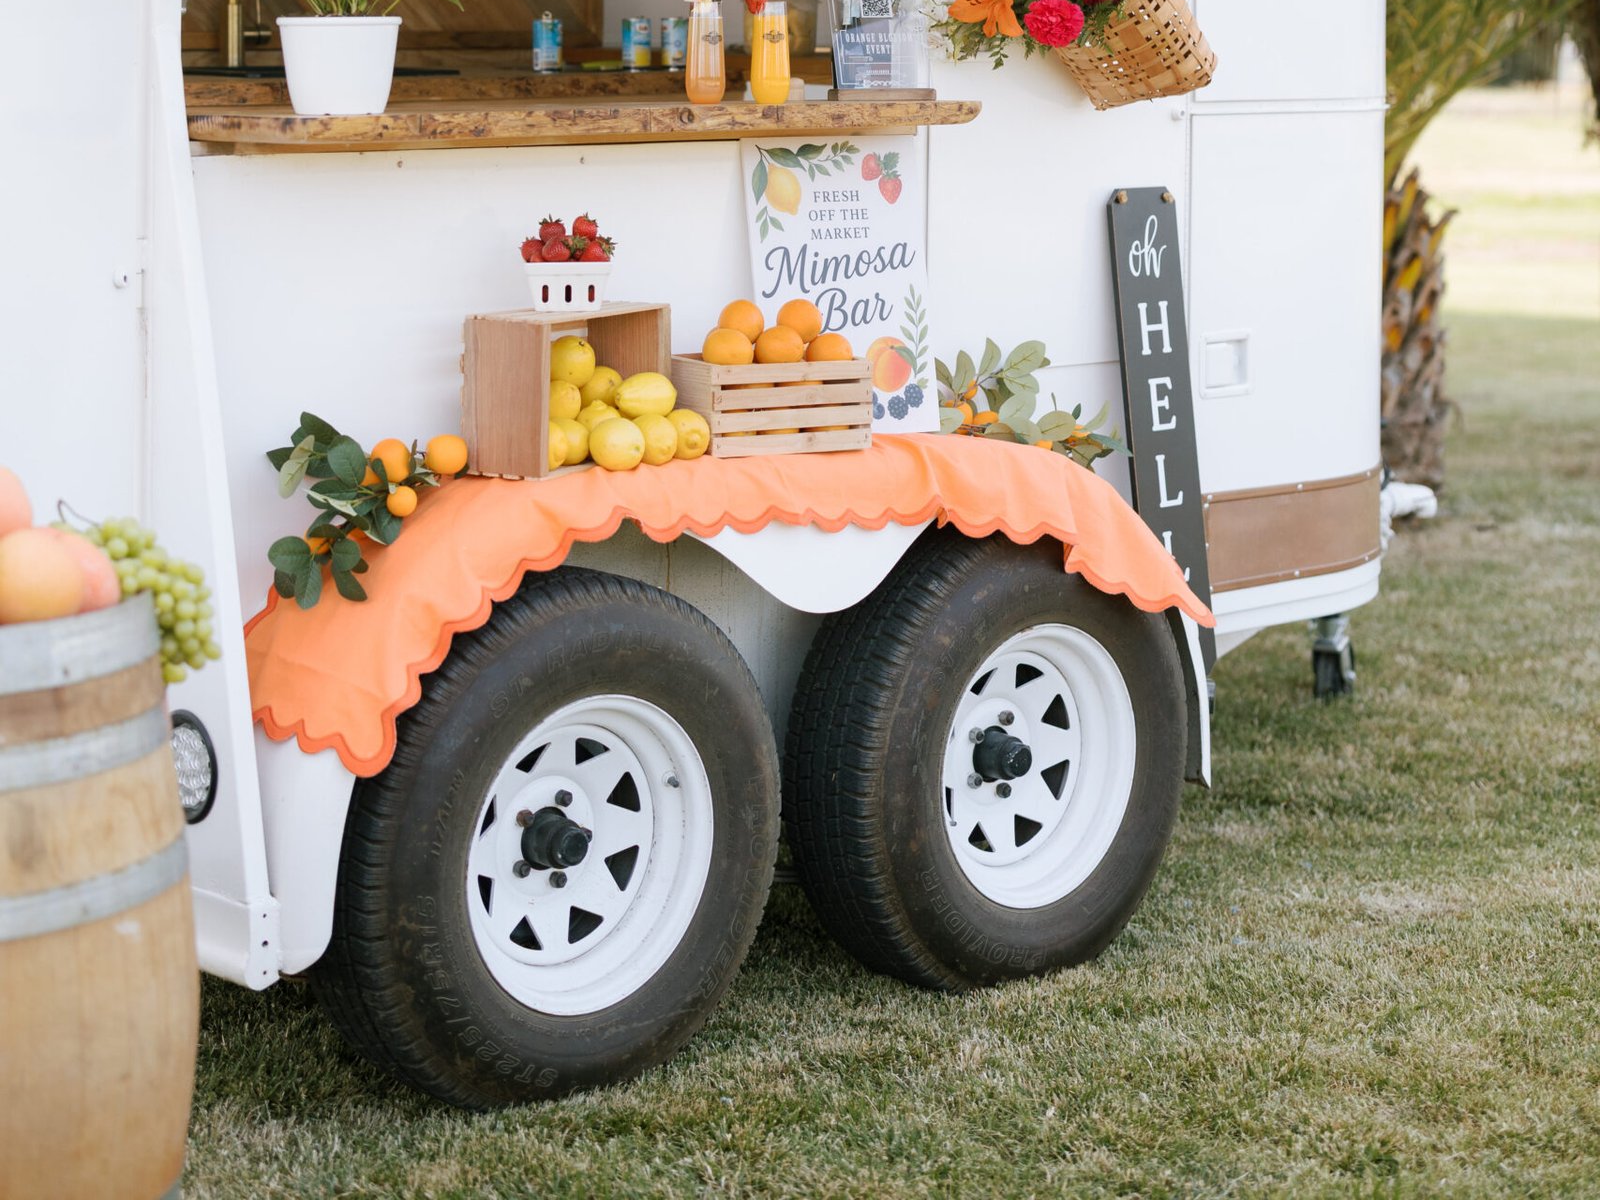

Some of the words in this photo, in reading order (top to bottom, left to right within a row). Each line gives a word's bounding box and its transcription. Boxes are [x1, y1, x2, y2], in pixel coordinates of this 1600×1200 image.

[845, 32, 876, 43] ORANGE
[808, 209, 836, 222] OFF
[841, 208, 869, 221] THE
[813, 190, 860, 203] FRESH
[811, 226, 870, 240] MARKET
[1128, 214, 1167, 279] oh
[762, 241, 916, 299] Mimosa
[815, 287, 894, 334] Bar
[920, 865, 1048, 970] PROVIDER
[416, 895, 559, 1088] ST225/75R15
